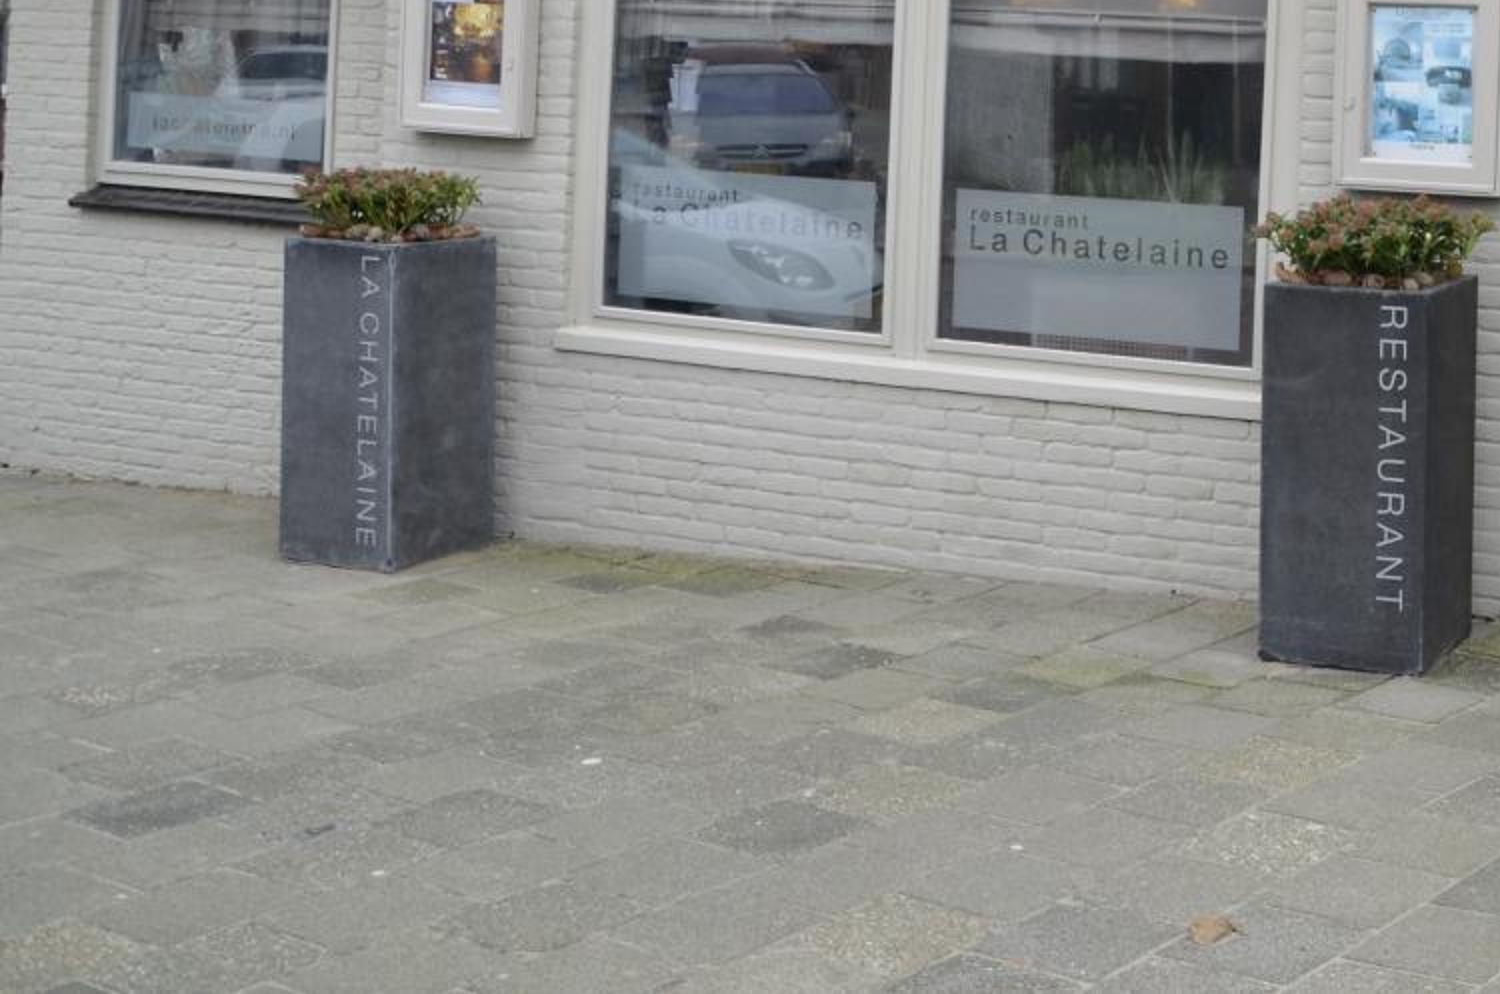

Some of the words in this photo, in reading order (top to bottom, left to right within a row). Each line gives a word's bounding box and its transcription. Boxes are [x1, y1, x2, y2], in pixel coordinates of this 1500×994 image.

[970, 206, 1089, 230] restaurant
[970, 225, 1008, 253] La
[1023, 228, 1229, 269] Chatelaine
[361, 255, 381, 298] LA
[355, 311, 380, 547] CHATELAINE
[1375, 304, 1408, 613] RESTAURANT
